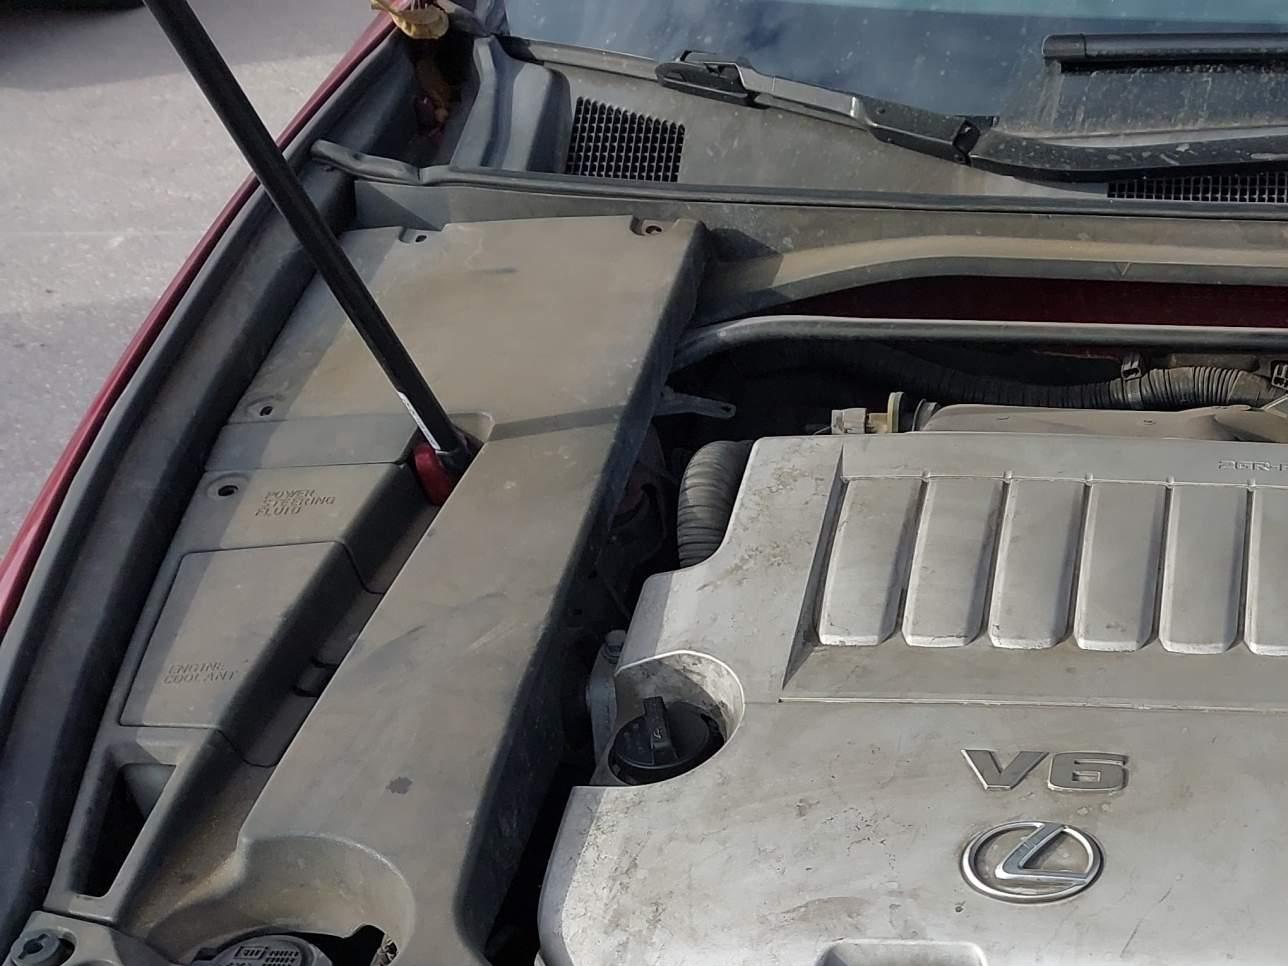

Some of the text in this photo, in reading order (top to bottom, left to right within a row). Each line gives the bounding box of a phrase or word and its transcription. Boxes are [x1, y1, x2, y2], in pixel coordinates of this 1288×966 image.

[262, 488, 317, 500] POWER
[261, 496, 336, 507] STEERING
[254, 505, 302, 516] FLUID
[162, 671, 235, 684] COOLANT
[960, 748, 1130, 792] V6
